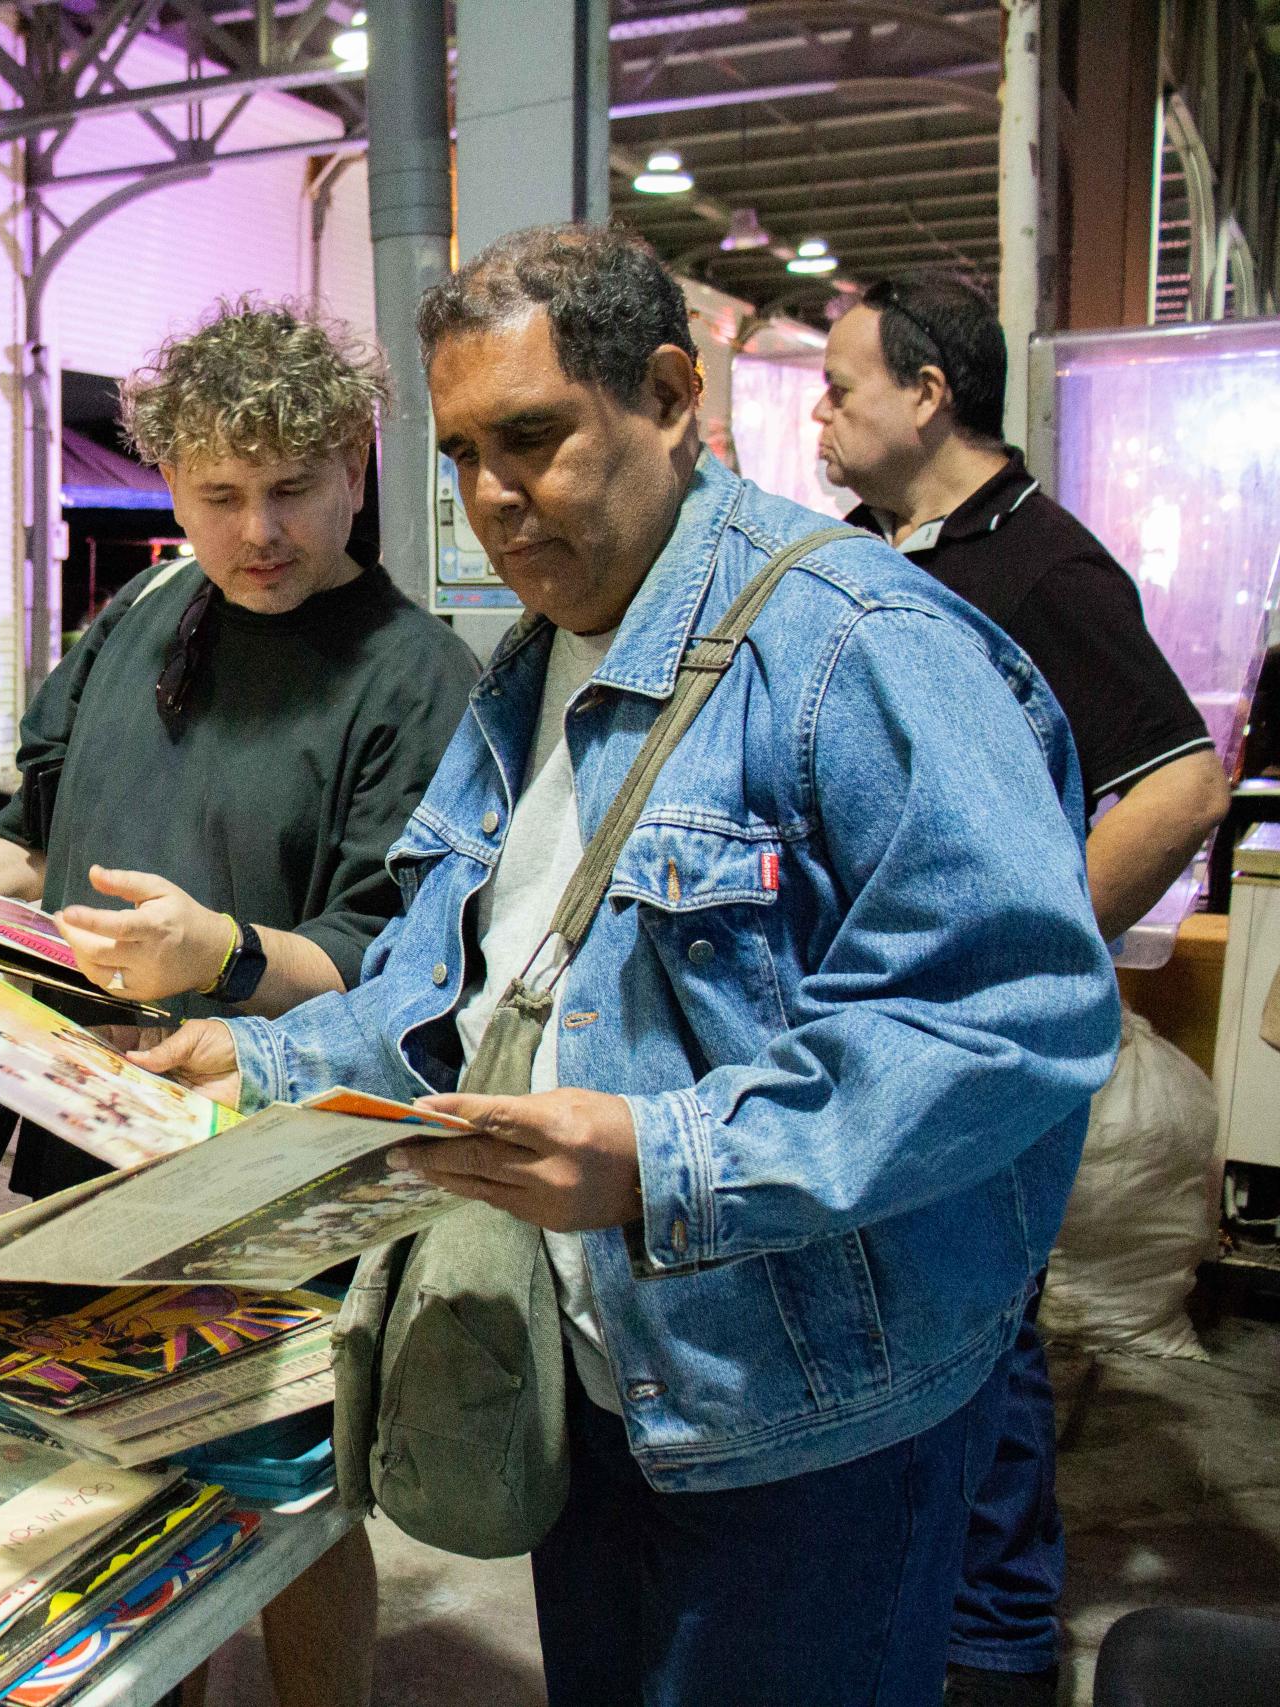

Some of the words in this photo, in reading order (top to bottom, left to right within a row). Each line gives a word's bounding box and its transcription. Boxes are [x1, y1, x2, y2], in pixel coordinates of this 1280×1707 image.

[58, 1481, 115, 1507] GOZA
[36, 1508, 66, 1524] MI
[2, 1523, 45, 1552] SON
